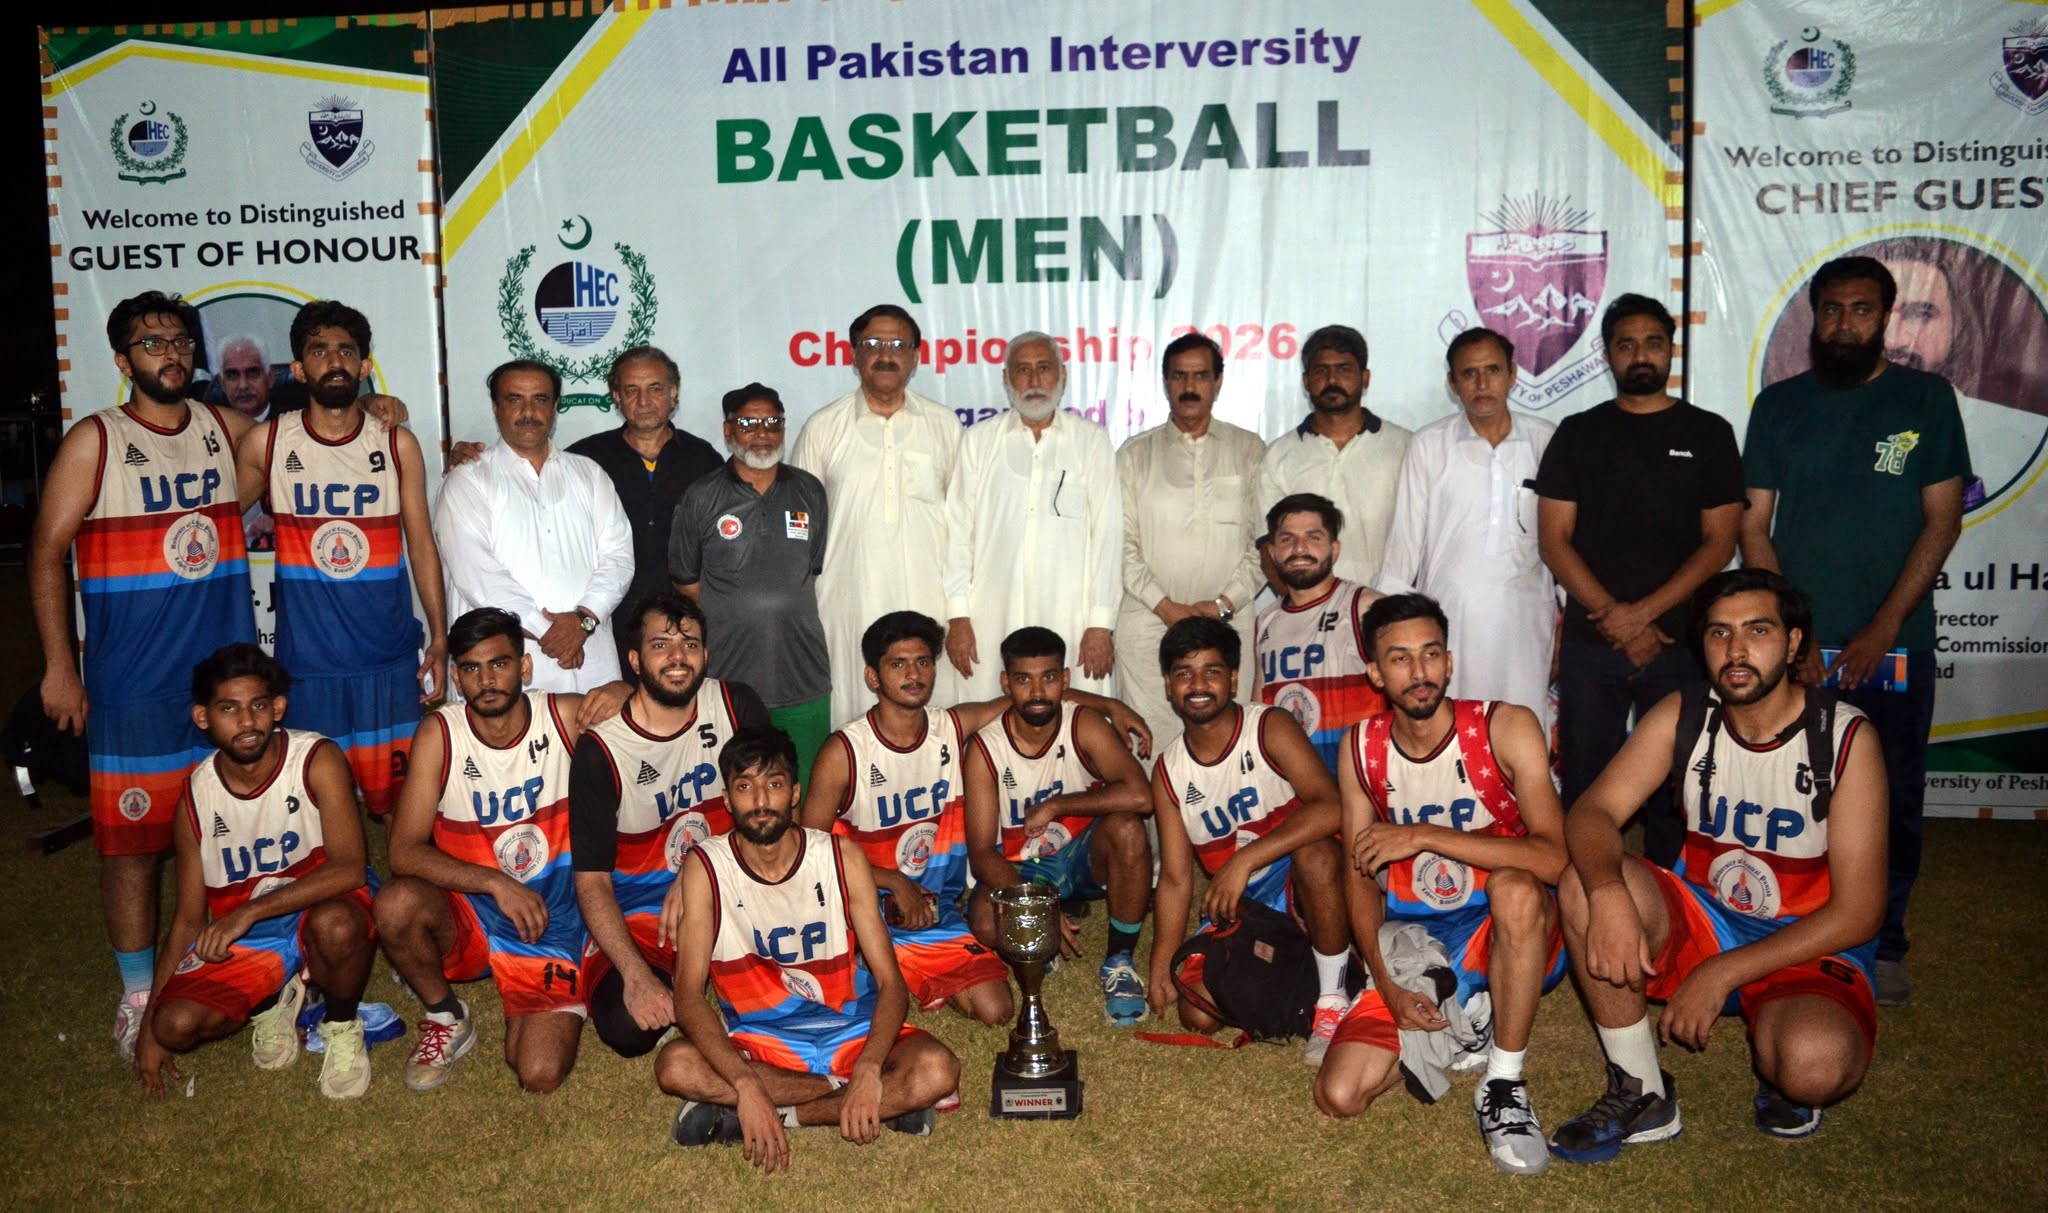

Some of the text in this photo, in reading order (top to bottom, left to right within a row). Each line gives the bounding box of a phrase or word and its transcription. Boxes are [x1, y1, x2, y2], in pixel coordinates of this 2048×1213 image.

[722, 28, 1362, 83] All Pakistan Interversity
[1810, 48, 1835, 69] HEC
[149, 121, 170, 141] HEC
[715, 100, 1371, 184] BASKETBALL
[1724, 146, 1861, 167] Welcome
[1872, 147, 1902, 165] to
[82, 199, 405, 230] Welcome to Distinguished
[1756, 176, 2048, 216] CHIEF GUES
[68, 234, 421, 271] GUEST OF HONOUR
[896, 213, 1180, 304] (MEN)
[575, 261, 620, 308] HEC
[789, 326, 1152, 374] Chpioship
[1544, 357, 1606, 398] PESHAWA
[1874, 441, 1907, 476] 78
[140, 467, 221, 513] UCP
[294, 482, 380, 516] UCP
[1964, 563, 1995, 590] ul
[1318, 610, 1339, 632] 12
[1262, 643, 1325, 683] UCP
[697, 723, 718, 749] 5
[472, 775, 545, 826] UCP
[655, 762, 717, 824] UCP
[1985, 775, 2006, 790] of
[2009, 775, 2048, 791] Pesh
[877, 779, 950, 828] UCP
[1700, 795, 1805, 852] UCP
[221, 830, 300, 883] UCP
[814, 881, 826, 907] 1
[1014, 1098, 1054, 1107] WINNER
